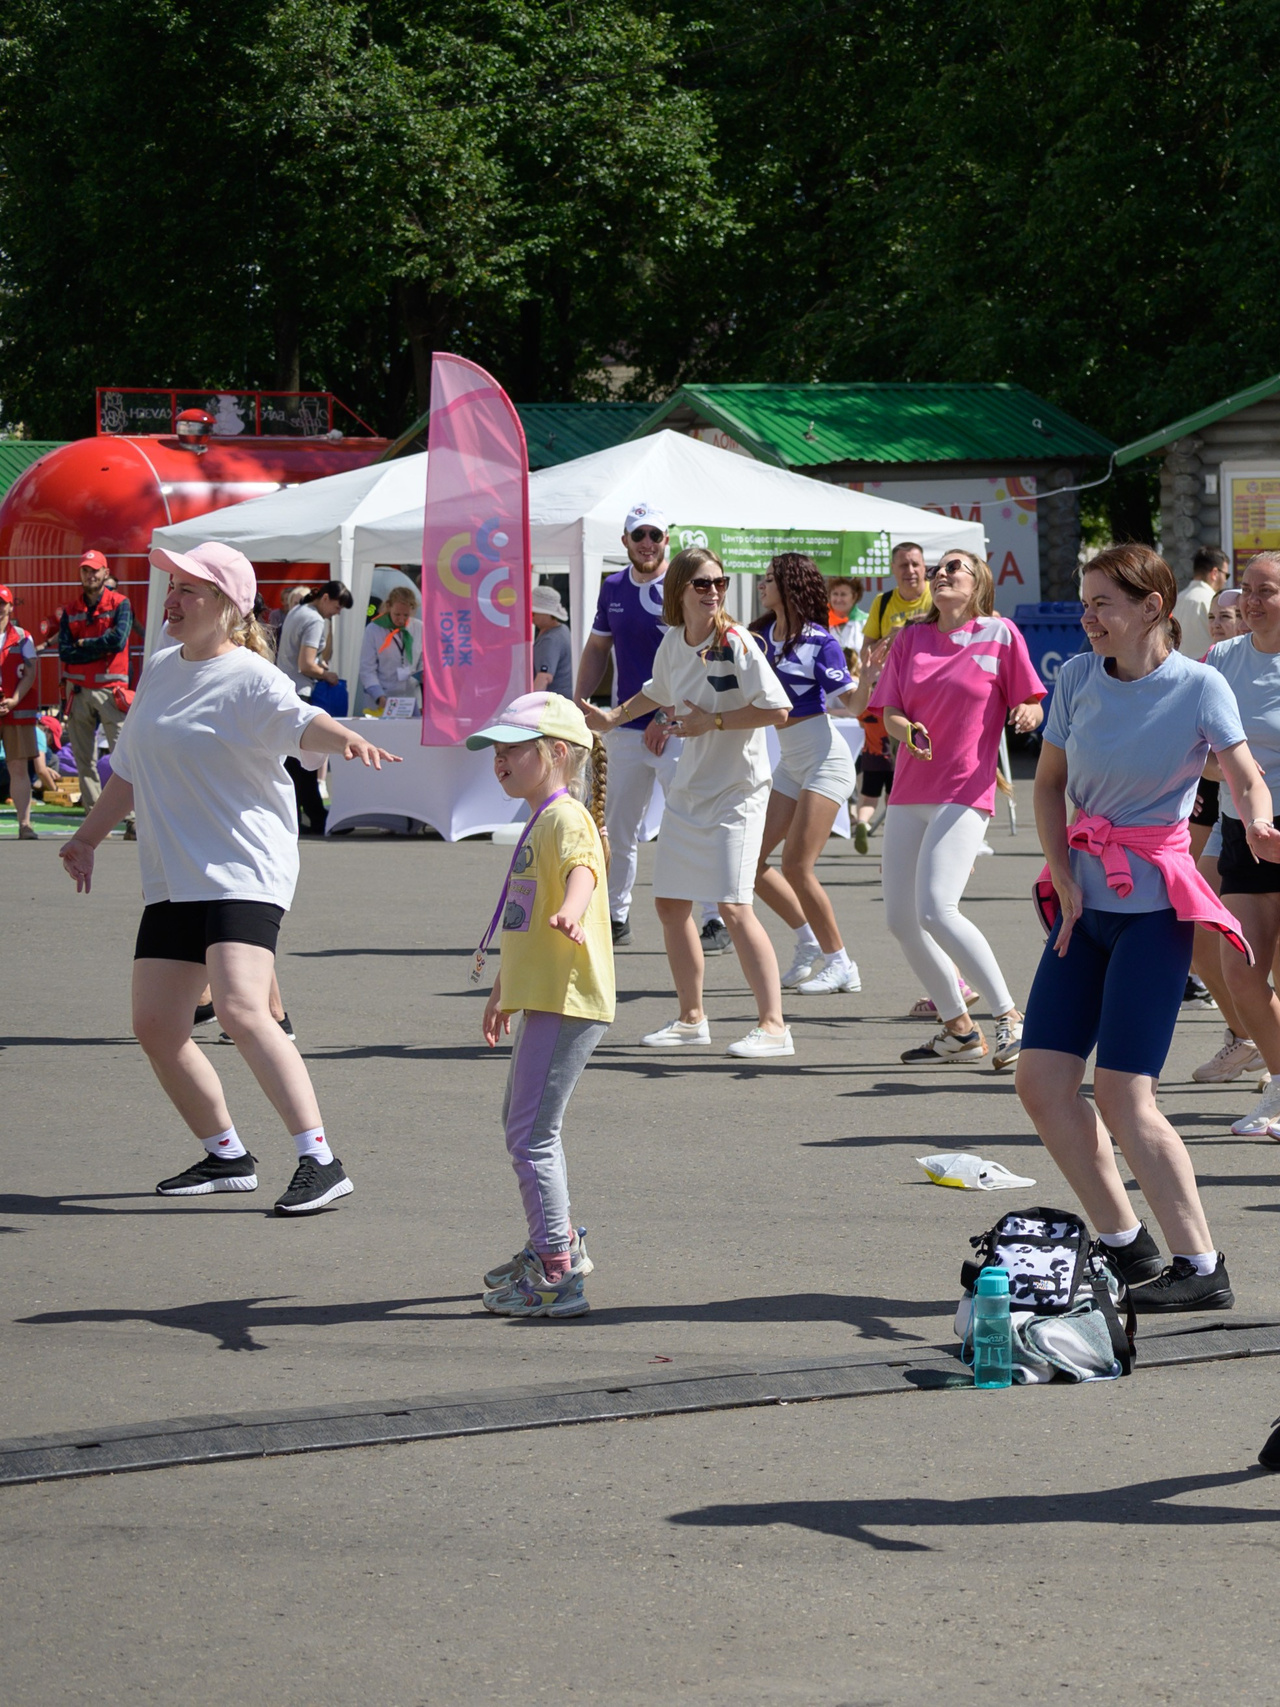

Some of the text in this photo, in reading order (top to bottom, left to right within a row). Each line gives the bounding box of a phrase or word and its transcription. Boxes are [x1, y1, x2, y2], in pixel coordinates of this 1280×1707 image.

[721, 534, 839, 545] Центр общественного здоровья
[723, 559, 762, 569] Кировской
